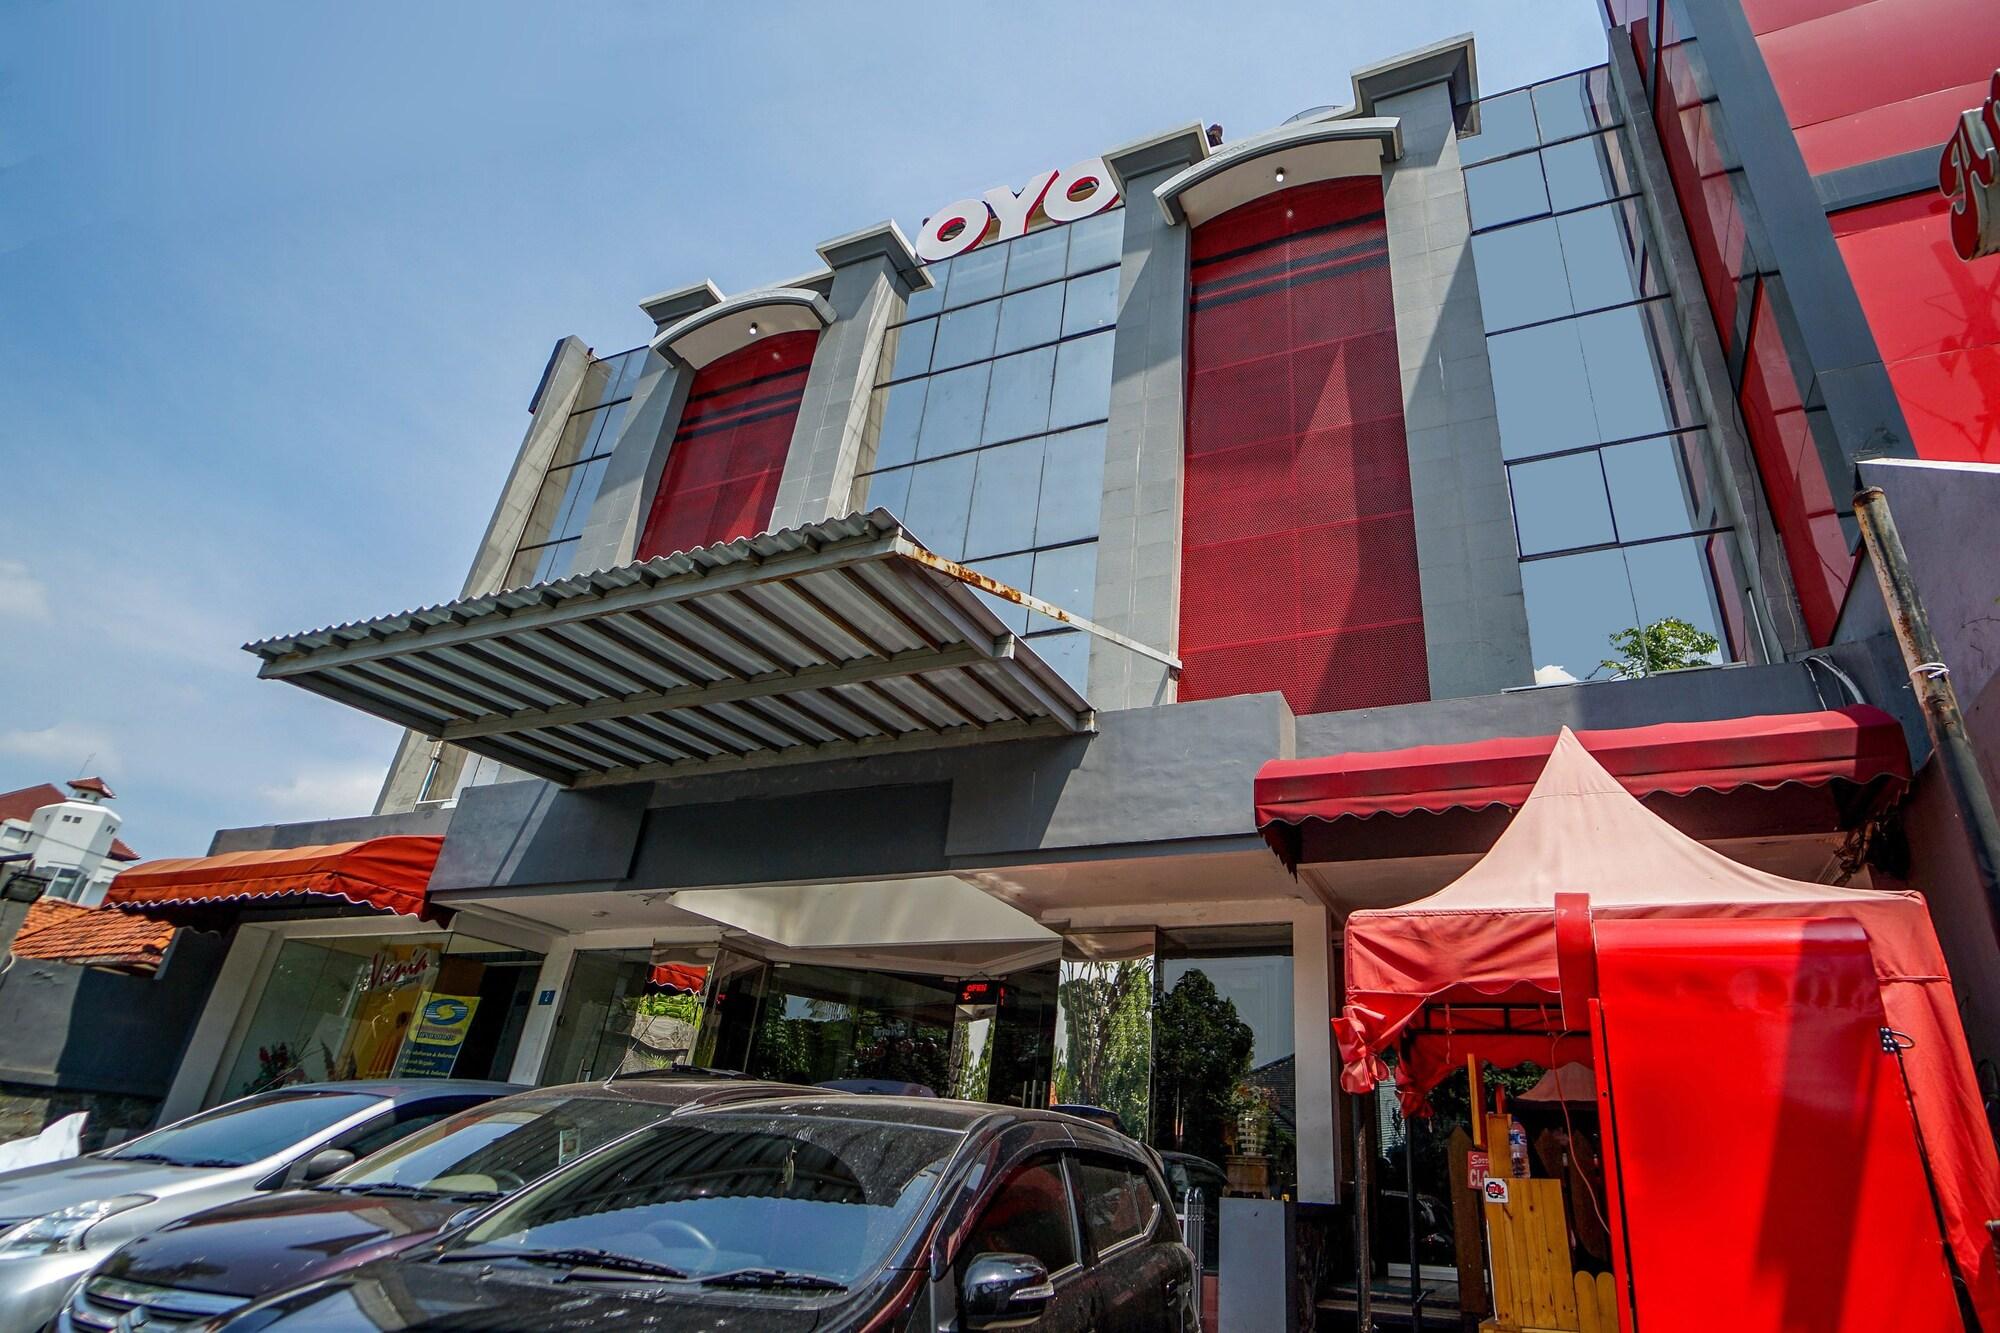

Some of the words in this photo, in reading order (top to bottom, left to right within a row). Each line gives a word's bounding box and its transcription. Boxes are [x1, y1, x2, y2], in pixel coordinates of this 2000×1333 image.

[916, 157, 1120, 263] OYO
[967, 984, 988, 992] OPEN
[1471, 1154, 1489, 1165] Sorr
